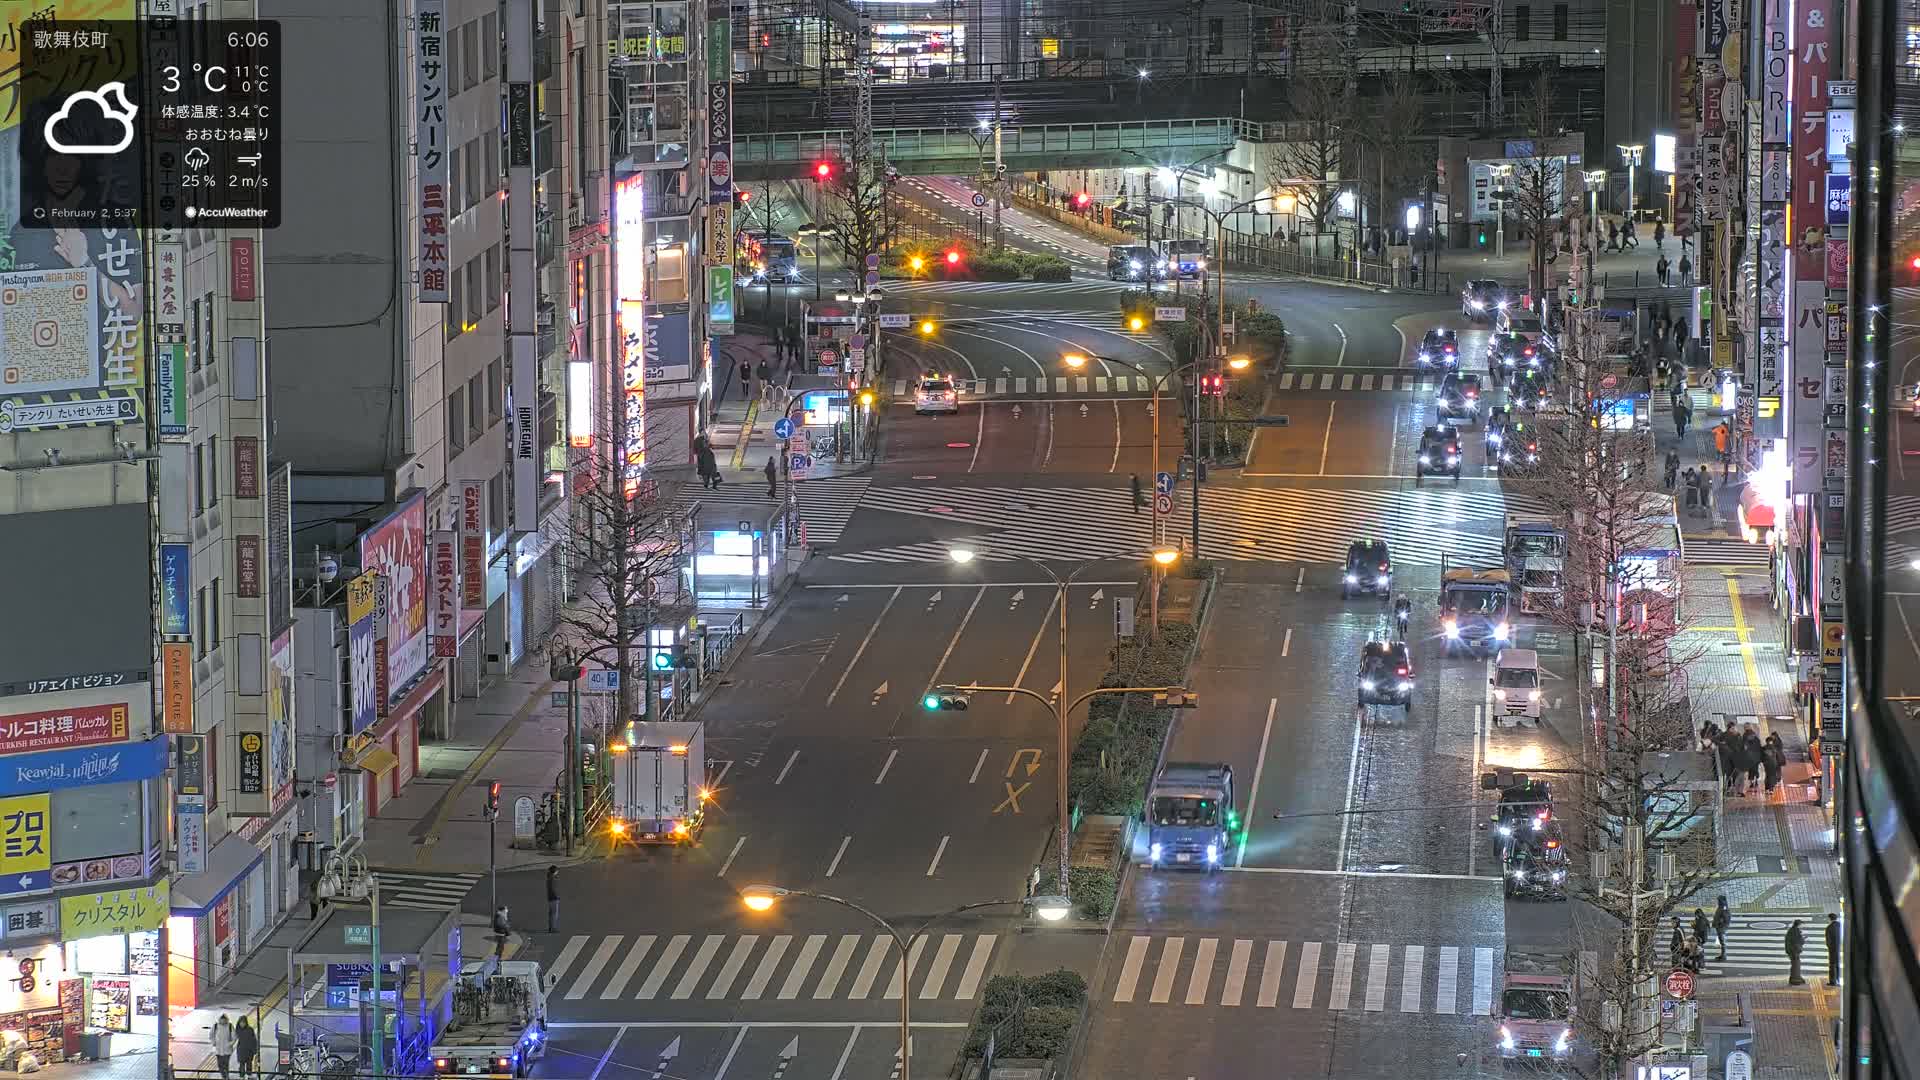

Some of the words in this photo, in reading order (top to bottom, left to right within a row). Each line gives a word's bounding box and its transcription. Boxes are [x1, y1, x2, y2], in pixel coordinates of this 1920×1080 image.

[420, 11, 442, 170] 新宿サンパーク
[422, 184, 445, 291] 三平本館
[1763, 330, 1776, 382] 大衆酒場
[161, 353, 173, 414] FamilyMart
[1831, 497, 1842, 506] 3F
[113, 711, 123, 735] 5F
[4, 811, 43, 835] プロ
[5, 836, 43, 858] ミス
[74, 903, 146, 926] クリスタル
[336, 962, 390, 972] SUBNAE
[331, 990, 346, 1004] 12
